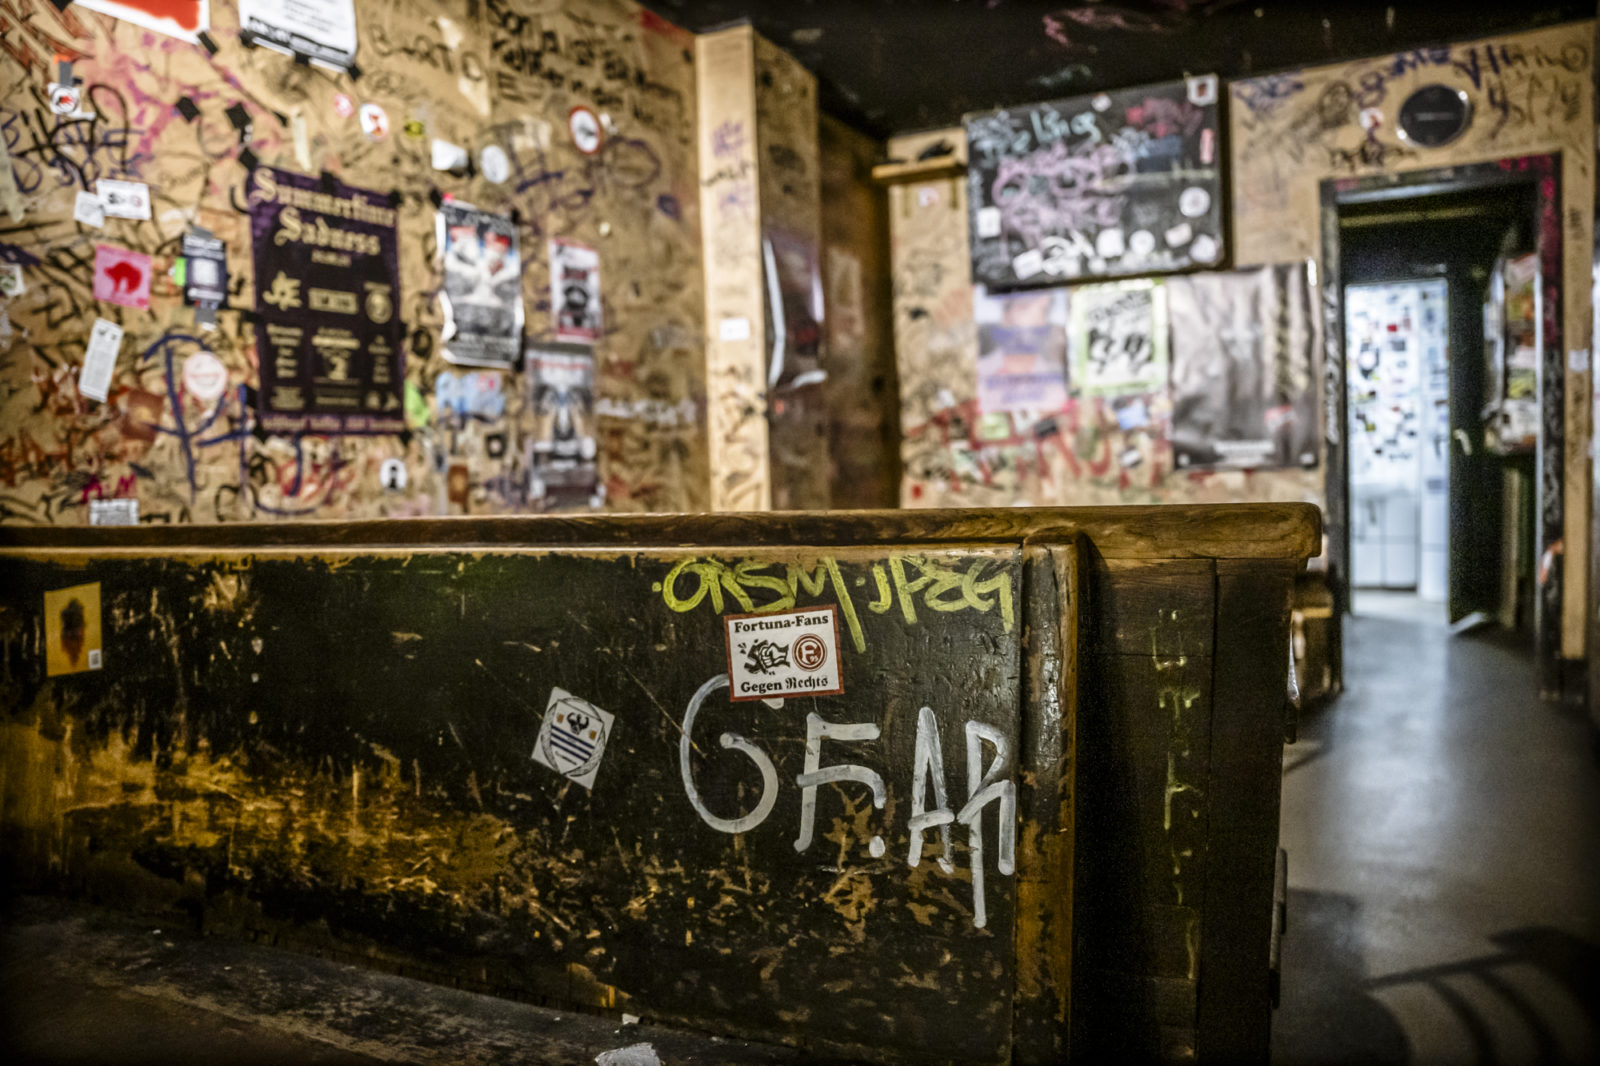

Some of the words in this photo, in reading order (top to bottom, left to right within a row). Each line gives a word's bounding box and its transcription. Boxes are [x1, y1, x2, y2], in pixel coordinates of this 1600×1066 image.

[273, 205, 381, 256] Sadness
[734, 614, 829, 633] Fortuna-Fans
[740, 681, 783, 694] Gegen
[785, 675, 829, 691] Rechts
